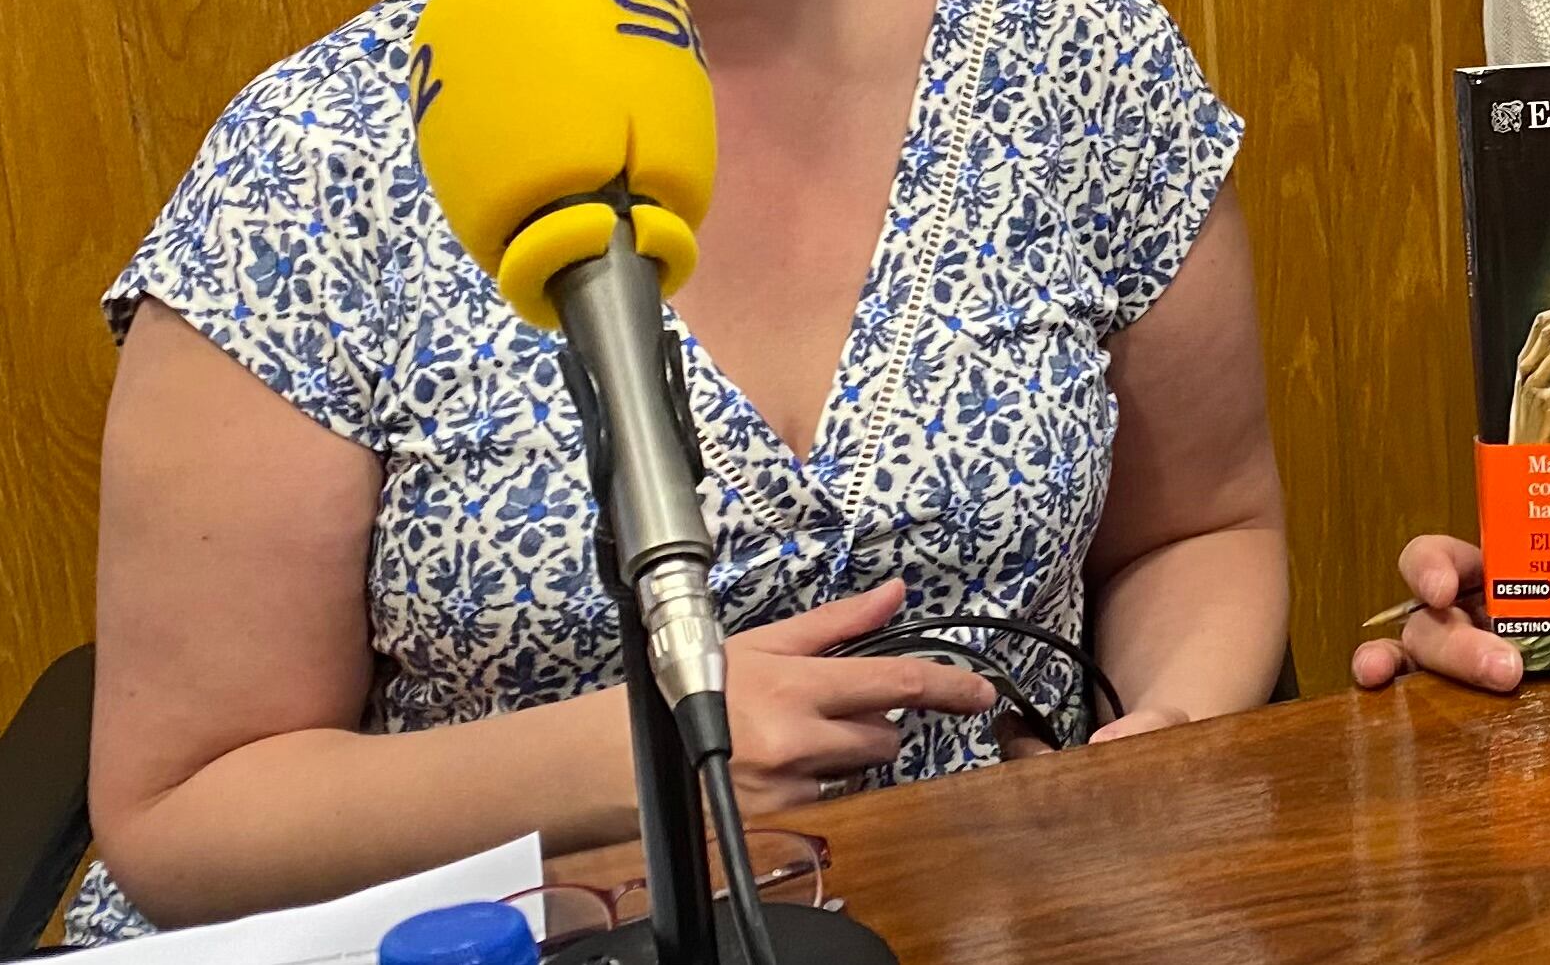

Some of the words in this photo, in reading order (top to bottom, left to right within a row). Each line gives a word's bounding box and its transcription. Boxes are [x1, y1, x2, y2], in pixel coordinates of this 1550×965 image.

[1530, 533, 1550, 551] El
[1496, 583, 1550, 596] DESTINO
[1497, 620, 1550, 634] DESTINO
